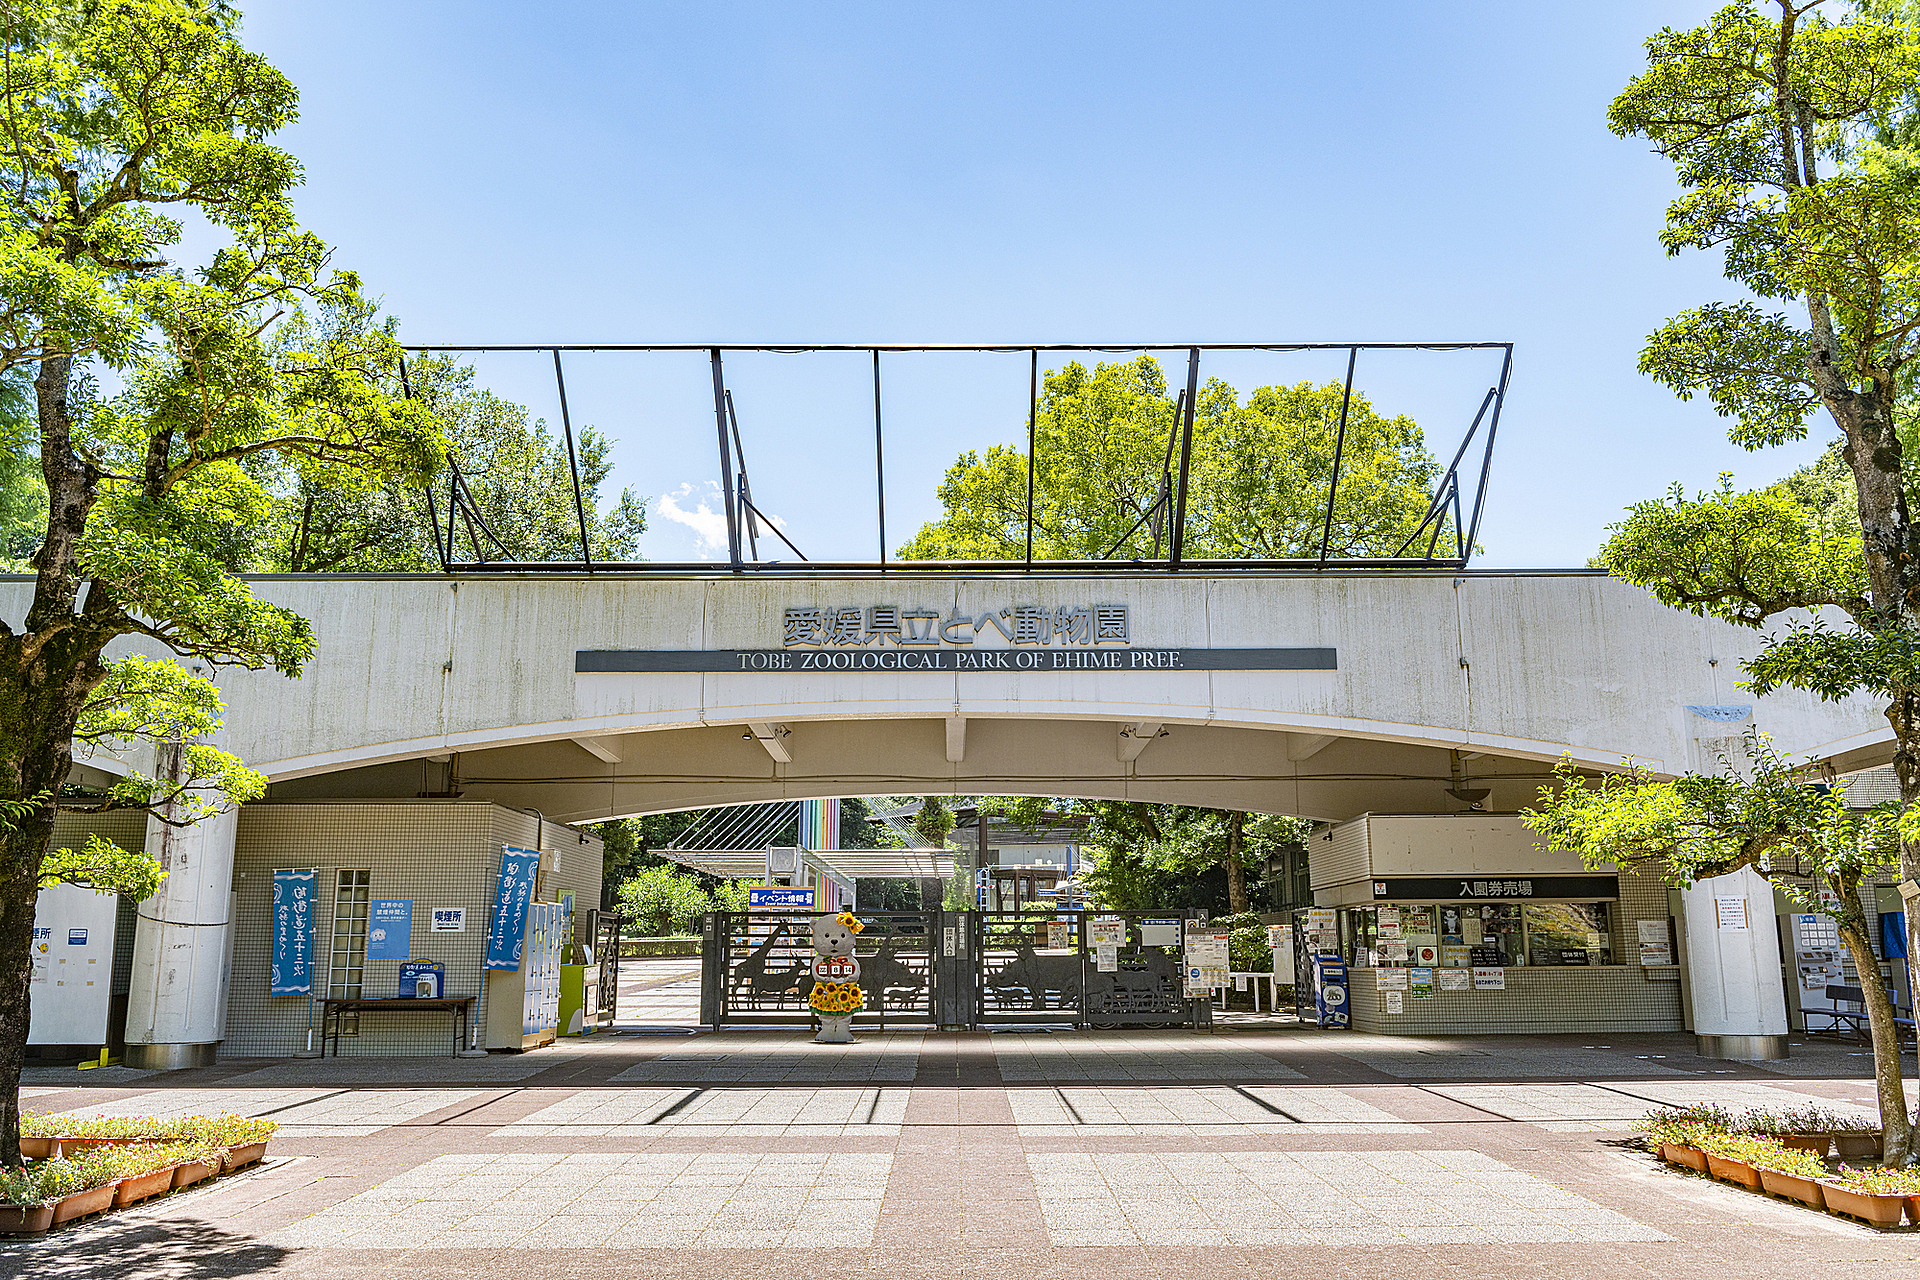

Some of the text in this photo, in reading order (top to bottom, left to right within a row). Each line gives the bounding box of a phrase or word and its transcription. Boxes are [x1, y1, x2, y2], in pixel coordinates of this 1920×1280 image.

[783, 605, 1131, 645] 愛媛県立とべ動物園
[737, 651, 1185, 670] TOBE ZOOLOGICAL PARK OF EHIME PREF.
[1459, 878, 1533, 898] 入園券売場
[759, 894, 805, 903] イベント情報
[434, 910, 462, 923] 喫煙所
[945, 928, 953, 956] 団体入口
